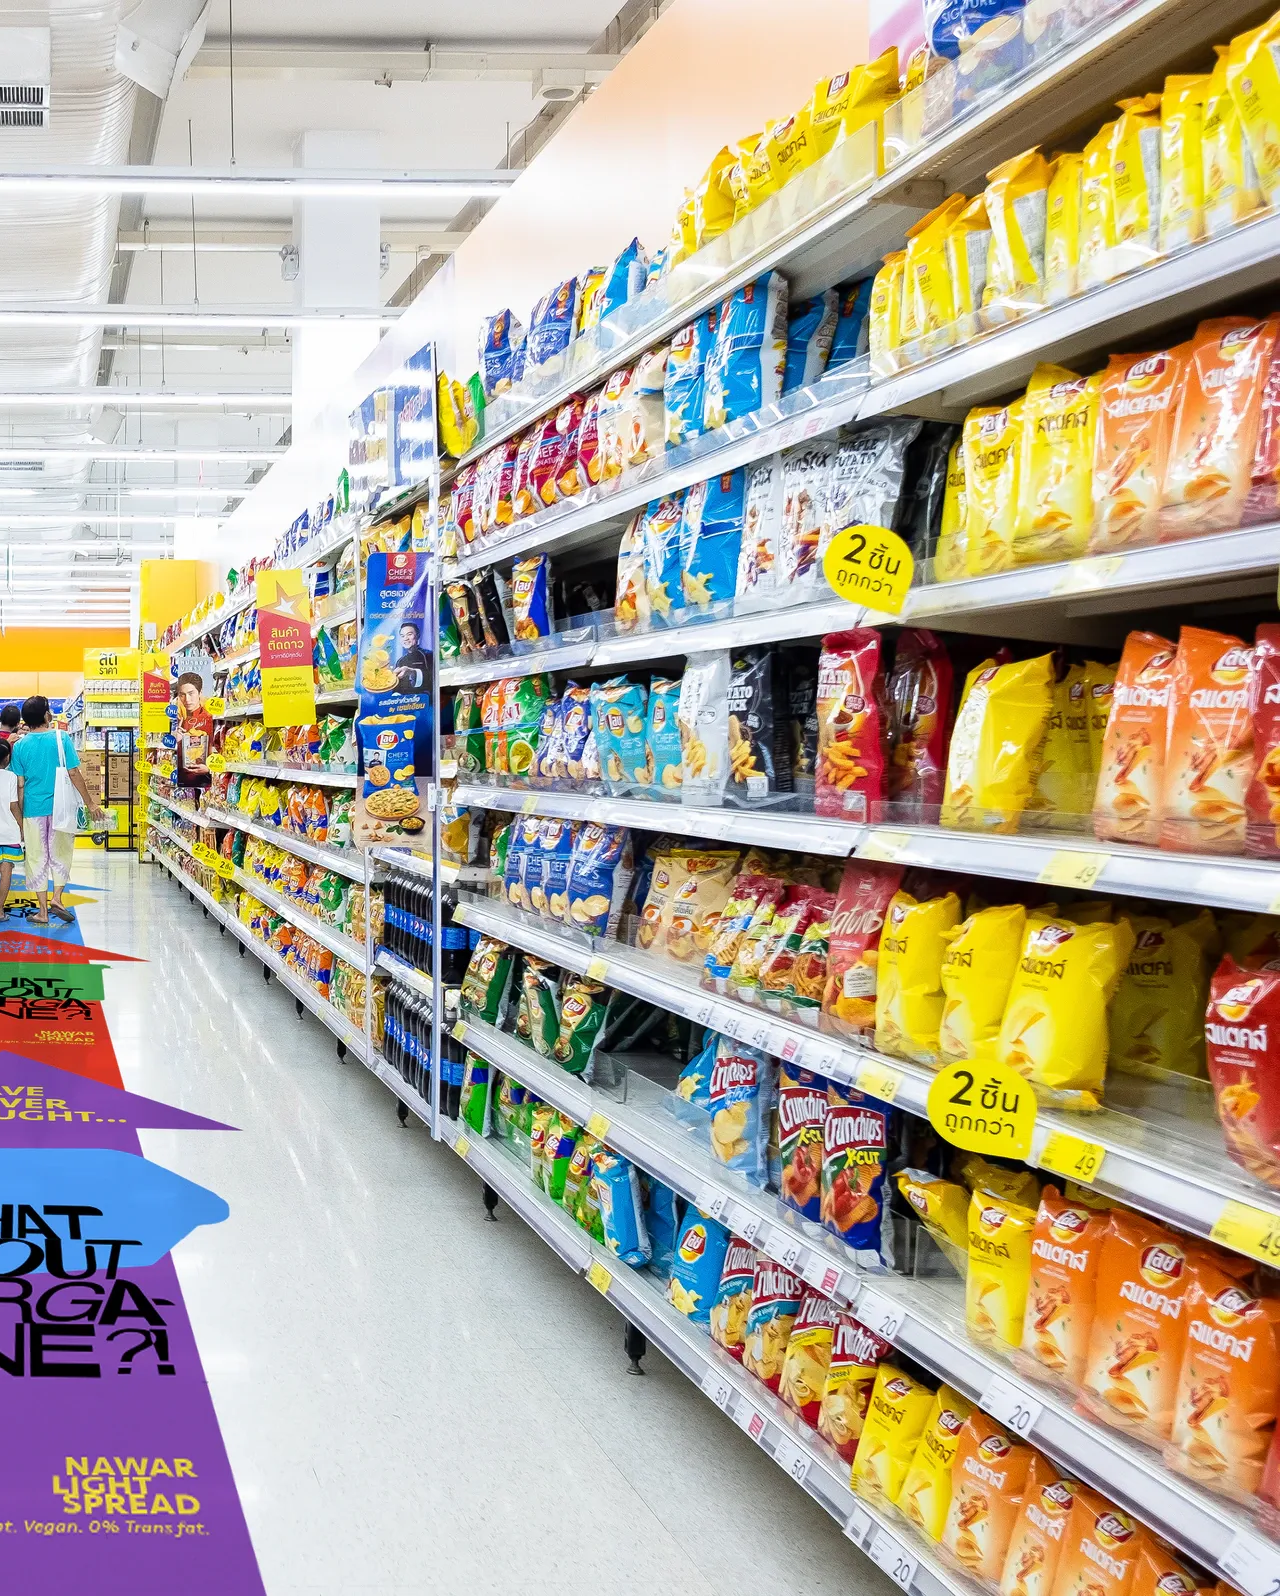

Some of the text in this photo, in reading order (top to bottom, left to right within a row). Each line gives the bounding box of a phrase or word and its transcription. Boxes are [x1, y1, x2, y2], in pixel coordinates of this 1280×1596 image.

[842, 534, 902, 576] 2 ชิ้น
[388, 568, 414, 577] CHEF'S
[836, 569, 893, 597] ถูกกว่า
[271, 626, 300, 639] สินค้า
[267, 639, 305, 651] ติดดาว
[1191, 689, 1250, 710] สแตค
[1075, 864, 1097, 883] 49
[880, 1079, 895, 1097] 49
[949, 1070, 1020, 1114] 2 ชิ้น
[779, 1089, 828, 1132] Crunchip
[824, 1111, 883, 1150] Crunchips
[945, 1112, 1016, 1138] ถูกกว่า
[797, 1127, 823, 1146] X-CU
[1074, 1157, 1096, 1176] 49
[709, 1199, 722, 1214] 49
[742, 1224, 755, 1240] 49
[1258, 1234, 1280, 1256] 49
[782, 1249, 796, 1266] 49
[752, 1266, 803, 1299] Crunchips
[1120, 1281, 1186, 1320] สแตคส์
[878, 1316, 898, 1337] 20
[1189, 1320, 1256, 1363] สแตคส์
[715, 1387, 728, 1406] 50
[1007, 1404, 1031, 1431] 20
[65, 1456, 198, 1478] NAWAR
[792, 1459, 806, 1480] 50
[52, 1475, 152, 1499] LIGHT
[62, 1494, 201, 1515] SPREAD
[23, 1520, 84, 1534] Vegan.
[88, 1519, 120, 1533] 0%
[892, 1558, 911, 1584] 20
